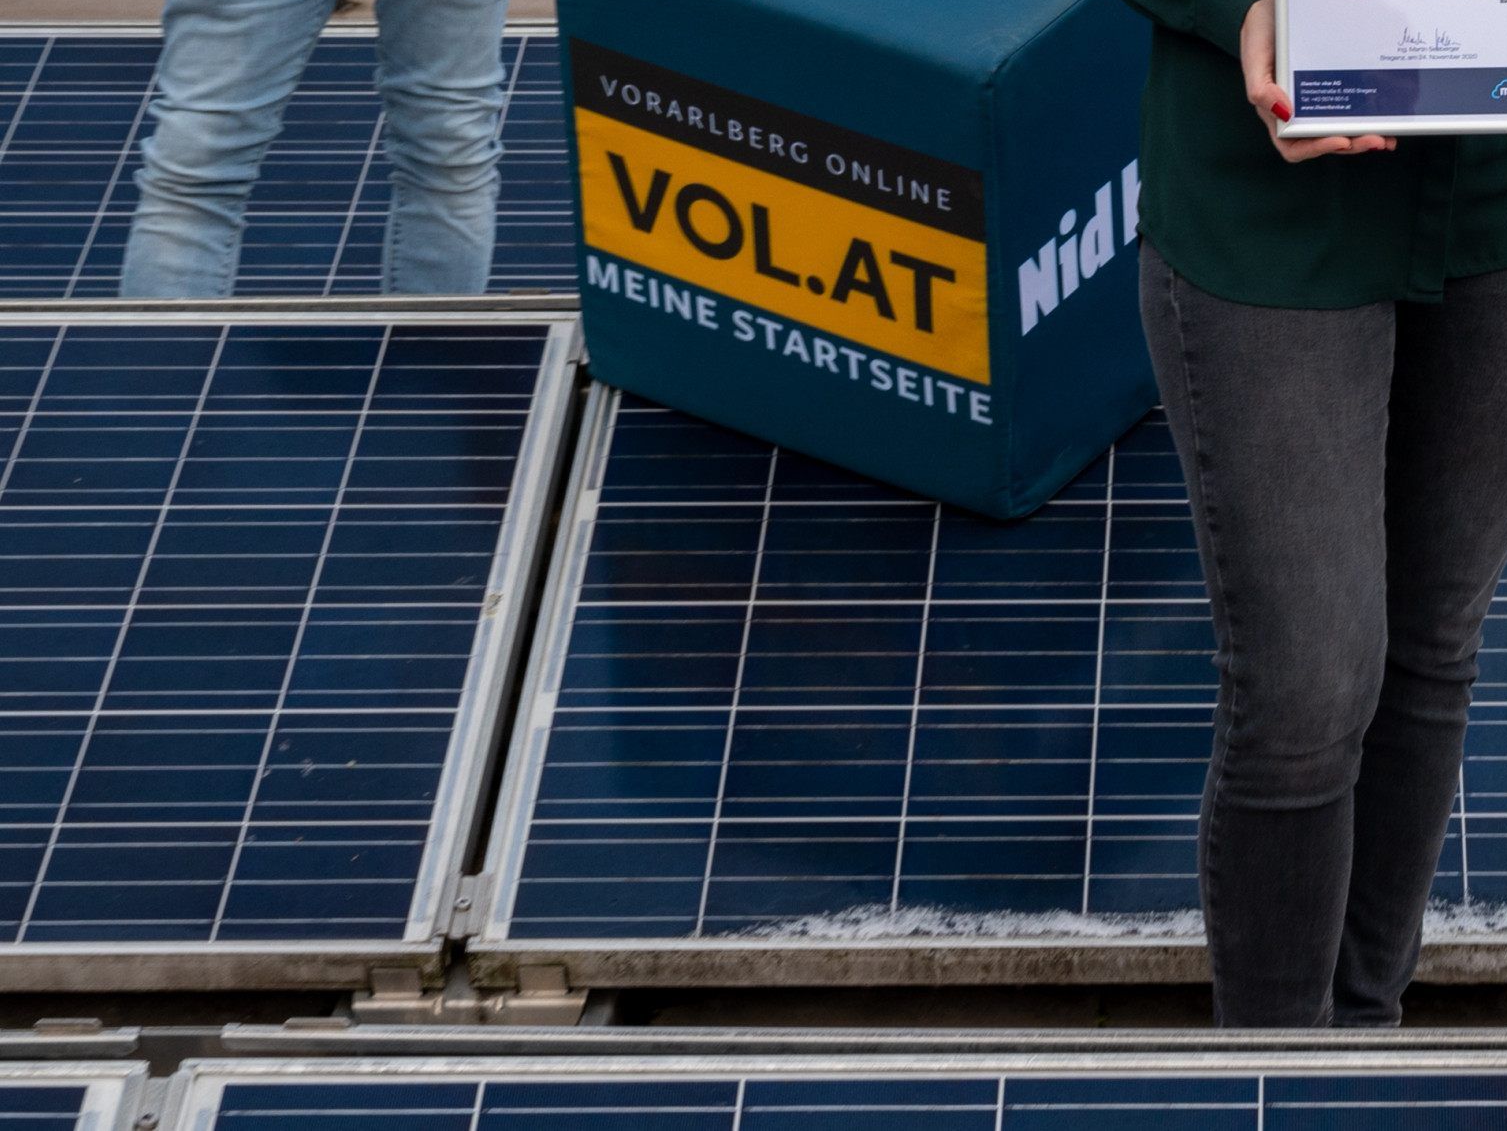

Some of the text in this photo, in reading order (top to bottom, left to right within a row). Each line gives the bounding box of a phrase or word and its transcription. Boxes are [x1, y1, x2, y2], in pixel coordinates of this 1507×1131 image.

[601, 74, 953, 212] VORARLBERG ONLINE
[607, 152, 956, 334] VOL.AT
[1018, 181, 1115, 337] Nid
[587, 255, 993, 426] MEINE STARTSEITE
